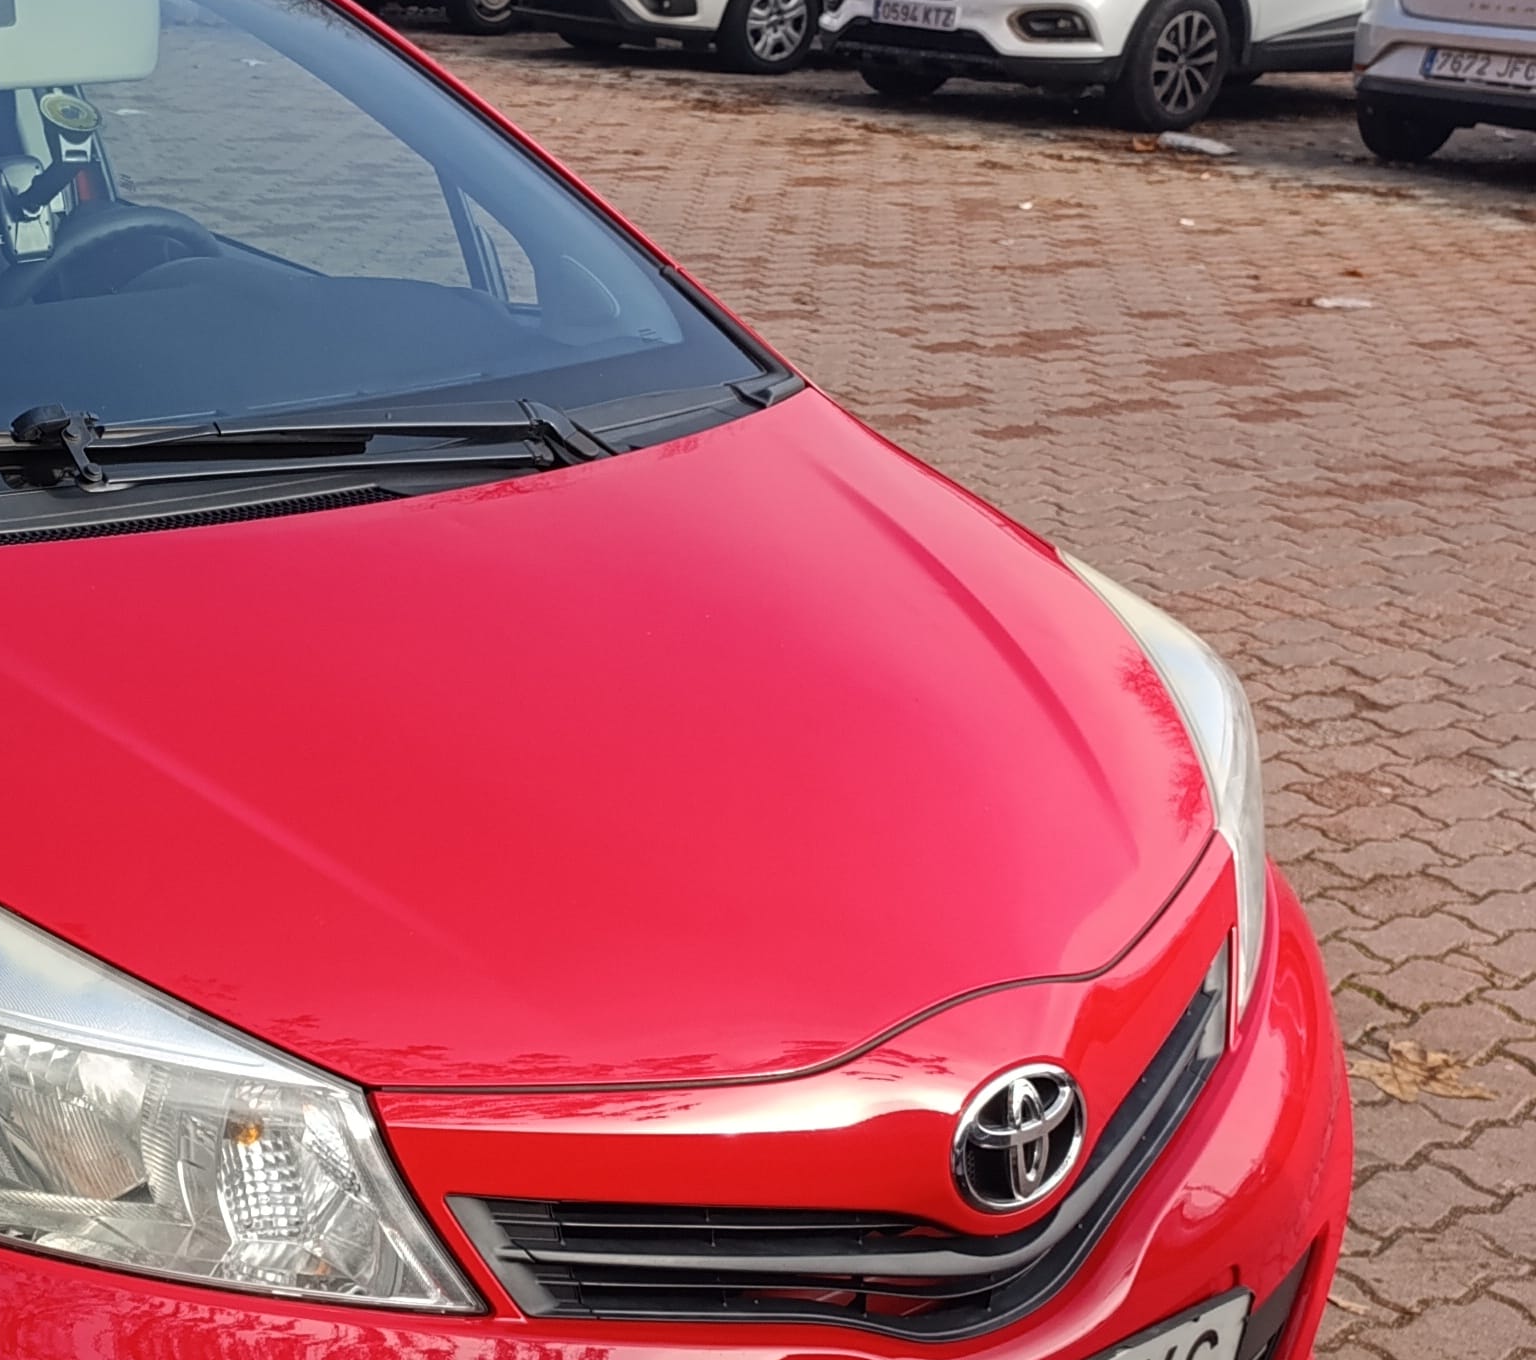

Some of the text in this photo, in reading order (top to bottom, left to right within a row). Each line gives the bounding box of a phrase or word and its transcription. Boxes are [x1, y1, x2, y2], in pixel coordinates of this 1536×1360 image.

[882, 2, 956, 28] 0594 KTZ
[1436, 52, 1492, 76] 7672
